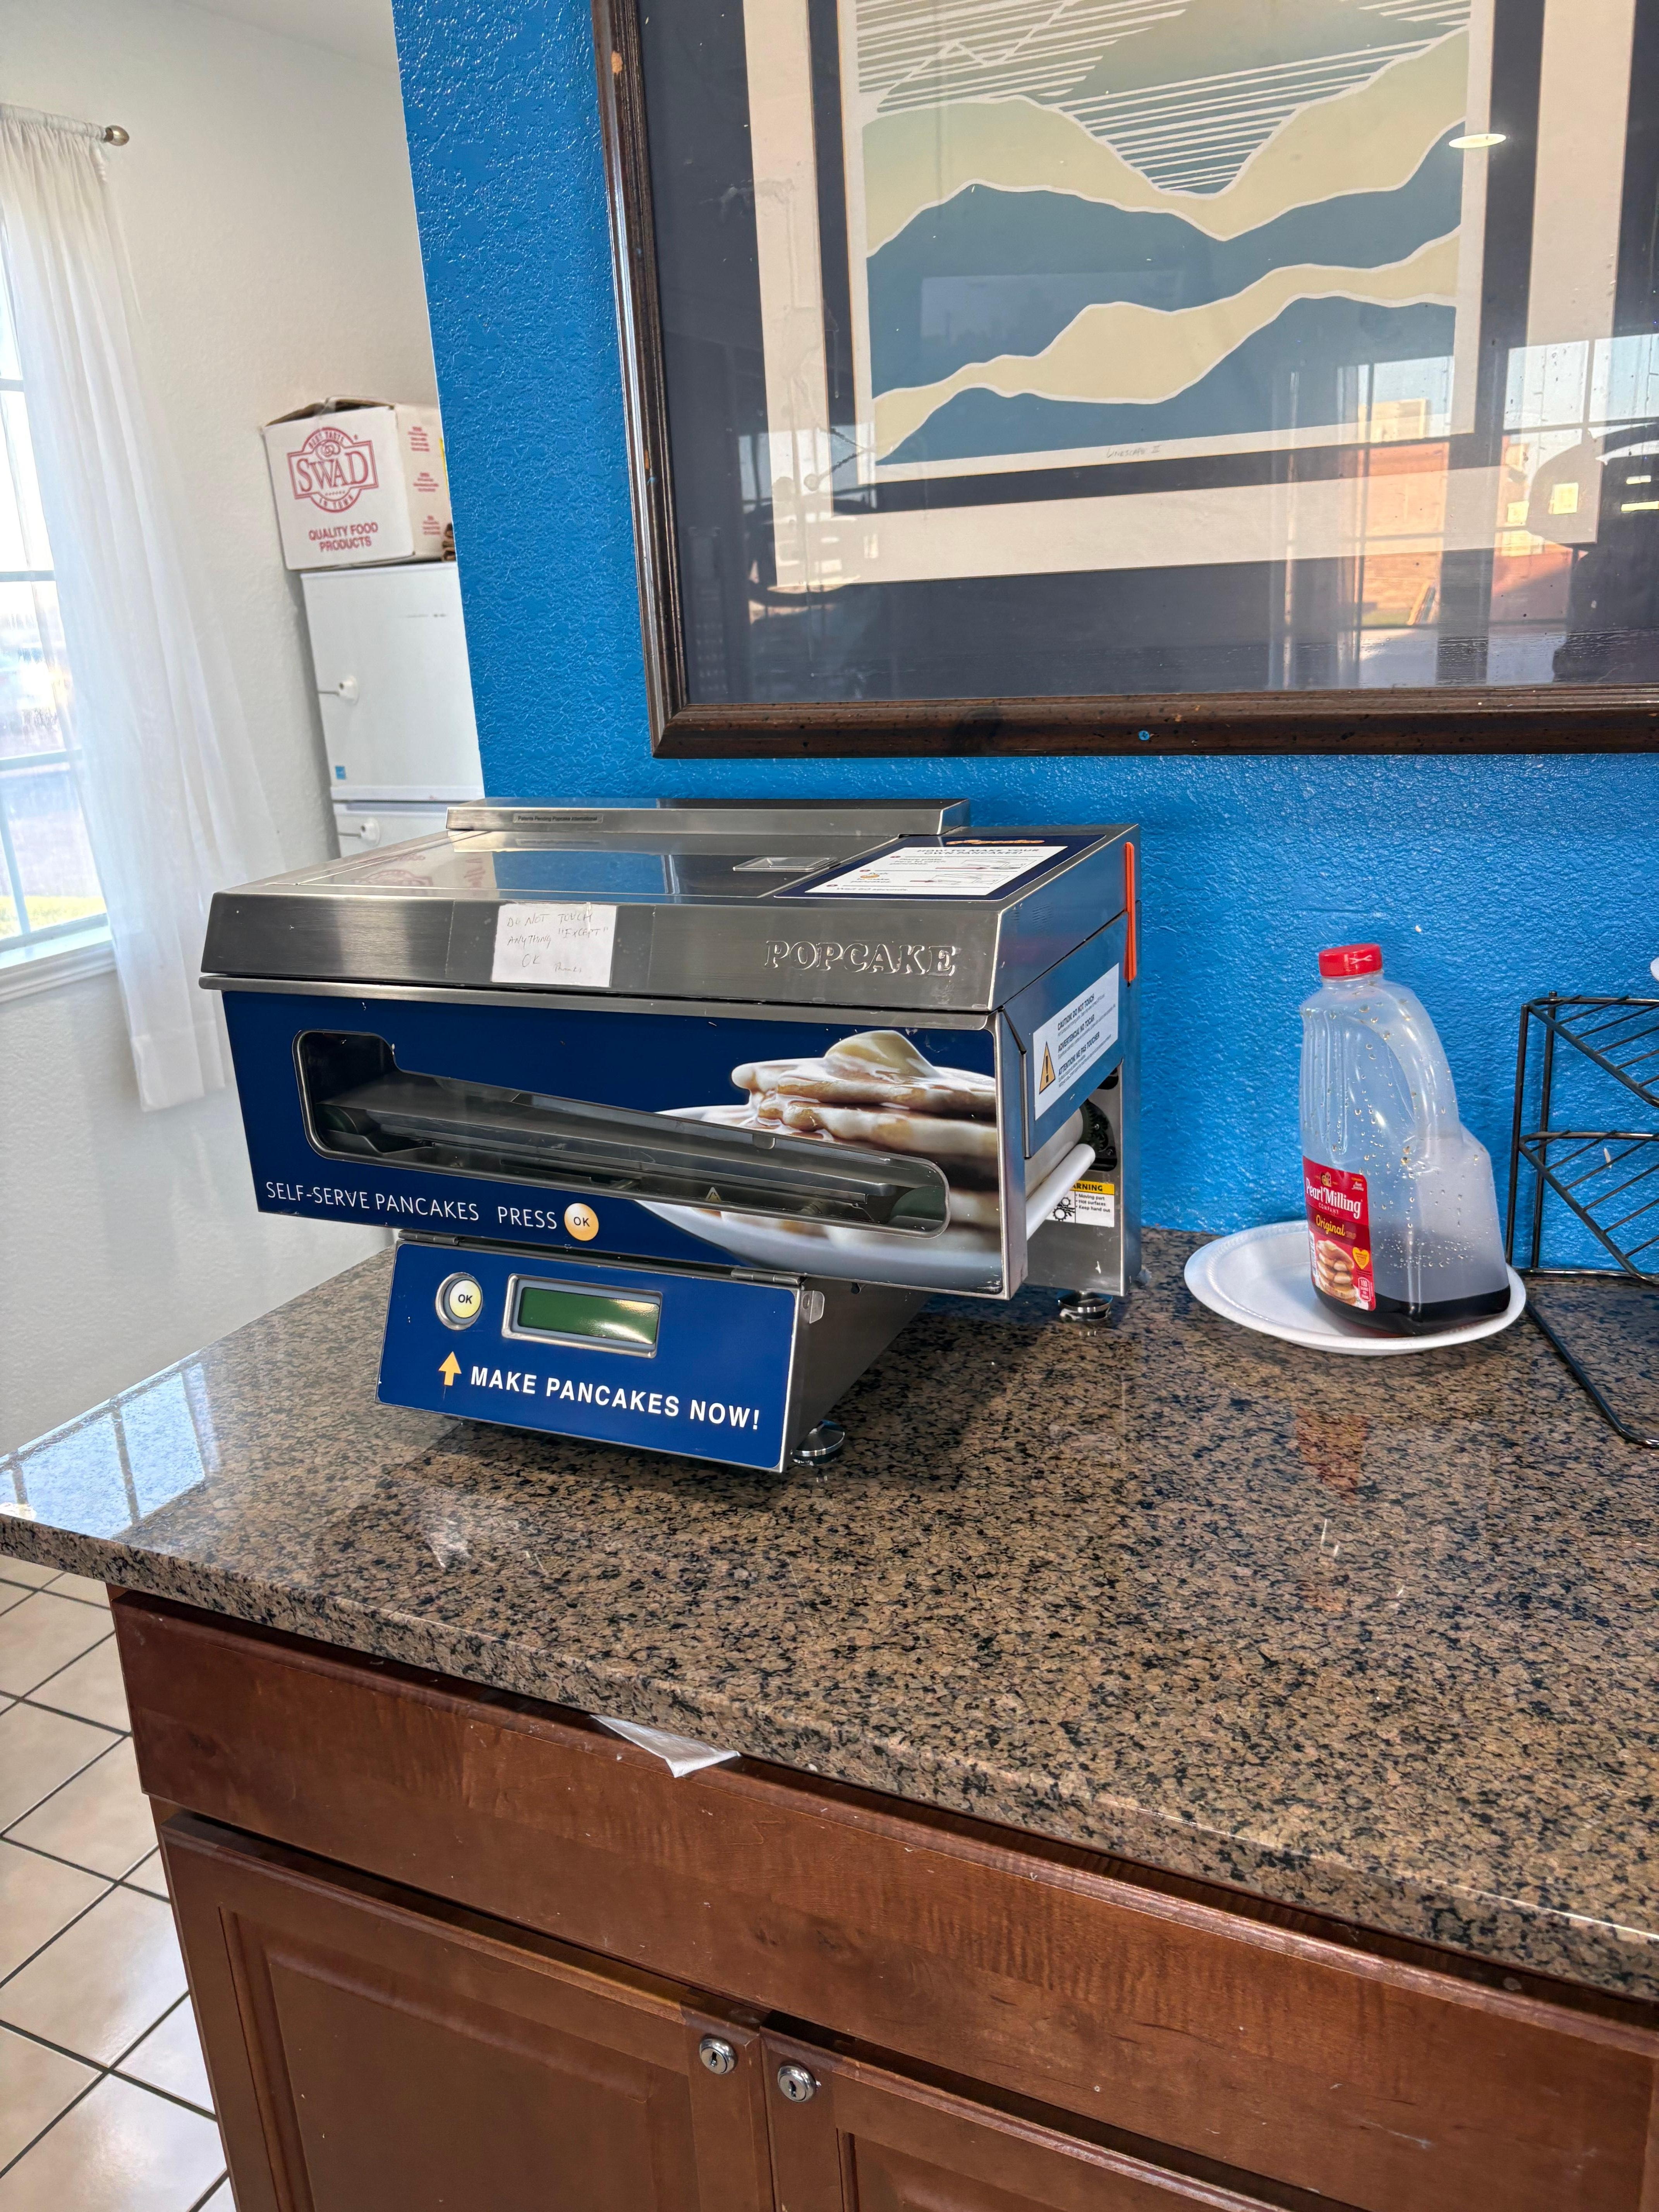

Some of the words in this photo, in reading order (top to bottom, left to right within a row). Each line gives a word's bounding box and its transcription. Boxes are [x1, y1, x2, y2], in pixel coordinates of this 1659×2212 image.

[295, 451, 369, 492] SWAD
[309, 526, 348, 541] QUALITY
[350, 522, 378, 534] FOOD
[319, 537, 372, 552] PRODUCTS
[507, 917, 521, 927] DO
[524, 913, 550, 926] NOT
[558, 912, 593, 924] TOUCH
[507, 934, 551, 949] ANYTHING
[522, 953, 540, 967] OK
[764, 940, 956, 976] POPCAKE
[1072, 1183, 1103, 1191] ARNING
[266, 1181, 370, 1209] SELF-SERVE
[375, 1193, 479, 1221] PANCAKES
[498, 1206, 557, 1230] PRESS
[573, 1216, 590, 1228] OK
[1305, 1177, 1324, 1202] Pearl
[1323, 1188, 1362, 1219] Milling
[1316, 1214, 1346, 1236] Original
[457, 1293, 473, 1305] OK
[471, 1365, 537, 1395] MAKE
[546, 1377, 679, 1417] PANCAKES
[689, 1399, 760, 1431] NOW!
